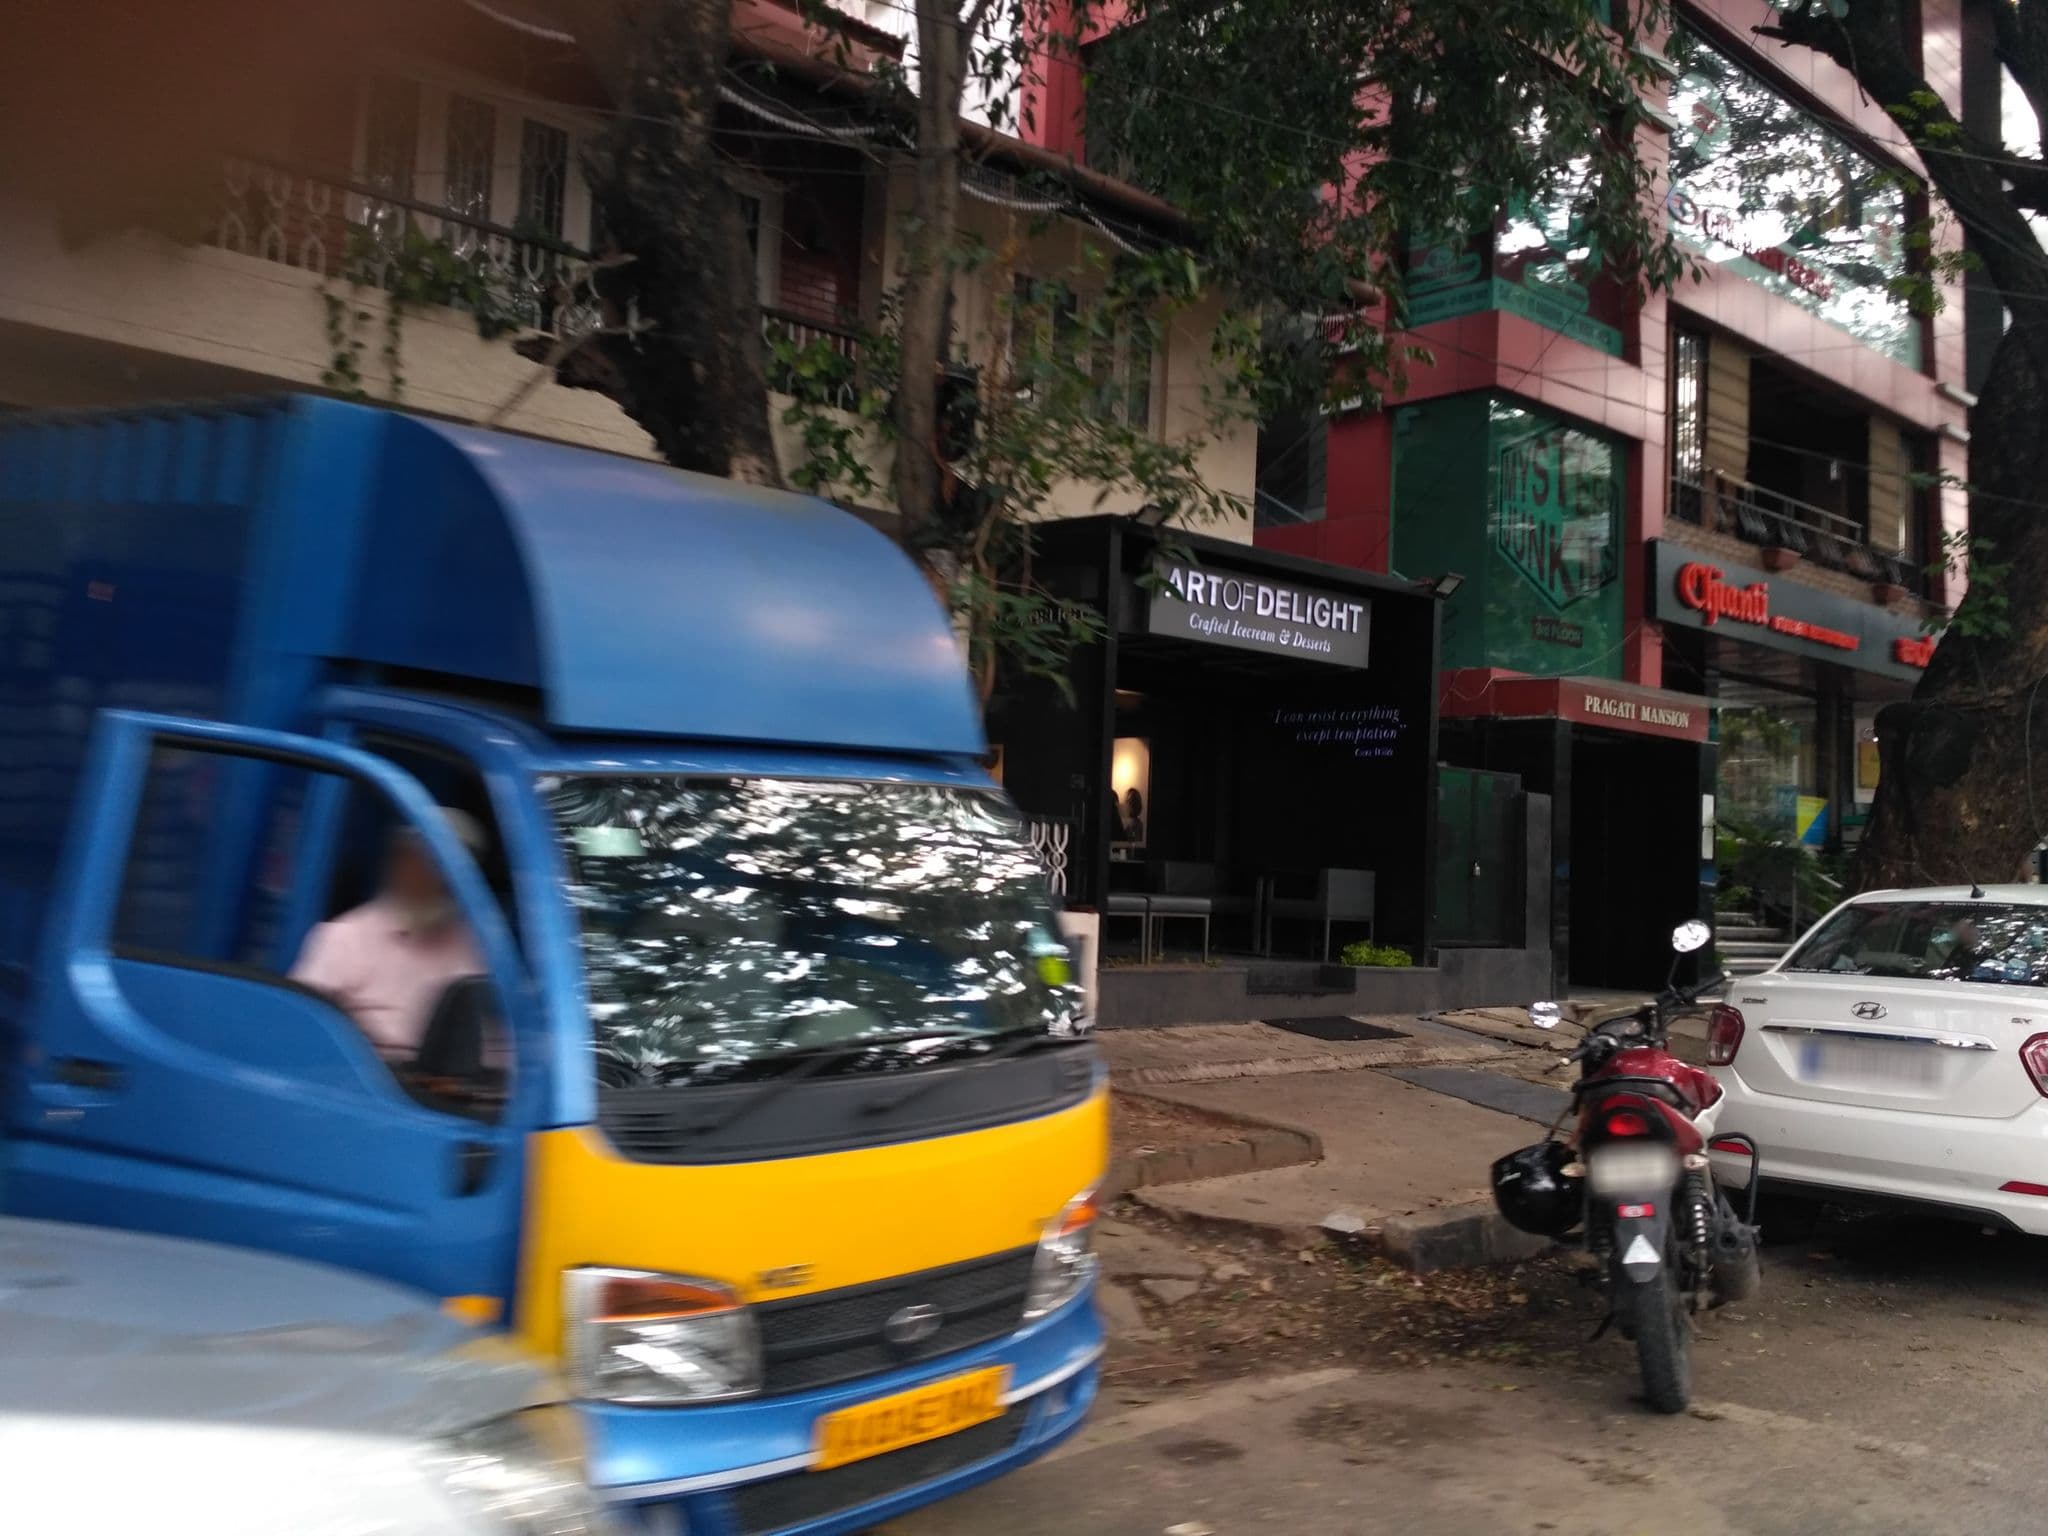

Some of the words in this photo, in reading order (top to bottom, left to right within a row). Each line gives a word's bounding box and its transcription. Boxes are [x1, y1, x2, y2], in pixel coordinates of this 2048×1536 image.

[1189, 612, 1229, 638] Crafted
[1231, 620, 1276, 643] Icecream
[1279, 628, 1291, 645] &
[1292, 631, 1331, 653] Desserts
[1339, 704, 1400, 727] everything
[1584, 694, 1636, 719] PRAGATI
[1640, 704, 1690, 728] MANSION
